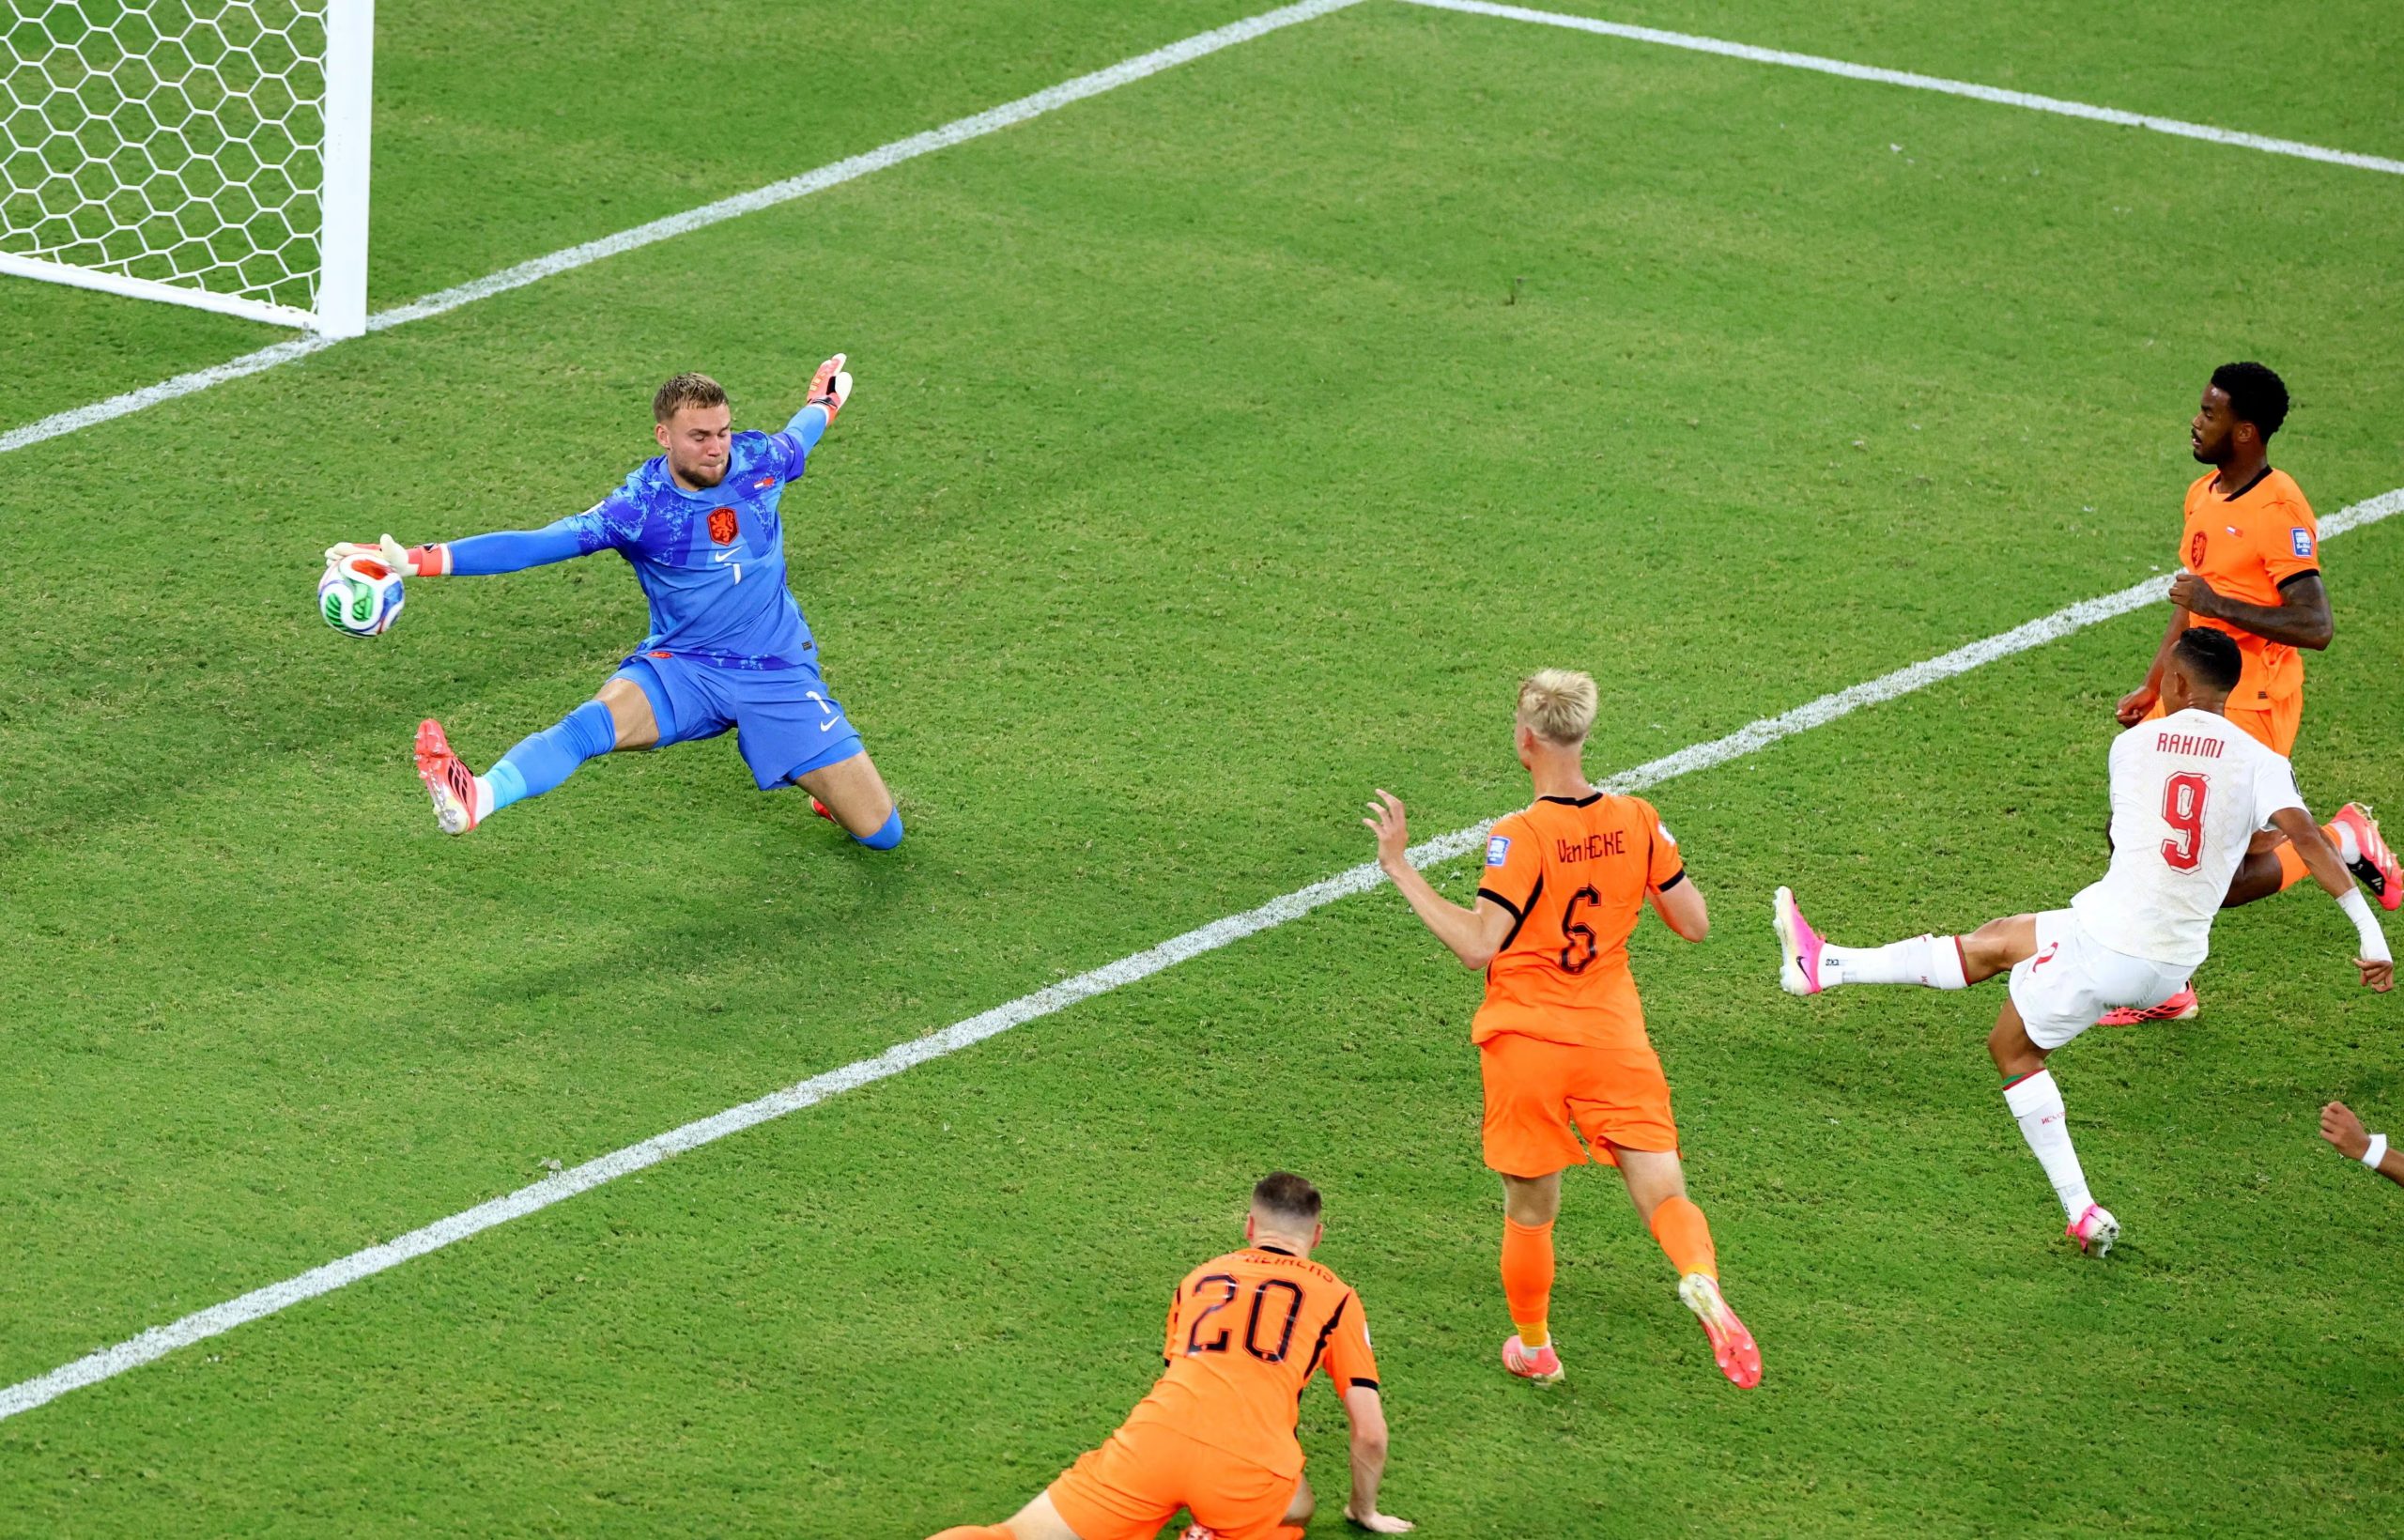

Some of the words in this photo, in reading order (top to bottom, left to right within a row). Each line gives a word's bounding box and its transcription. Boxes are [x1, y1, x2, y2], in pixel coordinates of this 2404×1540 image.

[806, 691, 831, 714] 1
[2156, 732, 2225, 759] RAHIMI
[2160, 770, 2211, 876] 9
[1561, 884, 1601, 974] 6
[1187, 1273, 1305, 1364] 20
